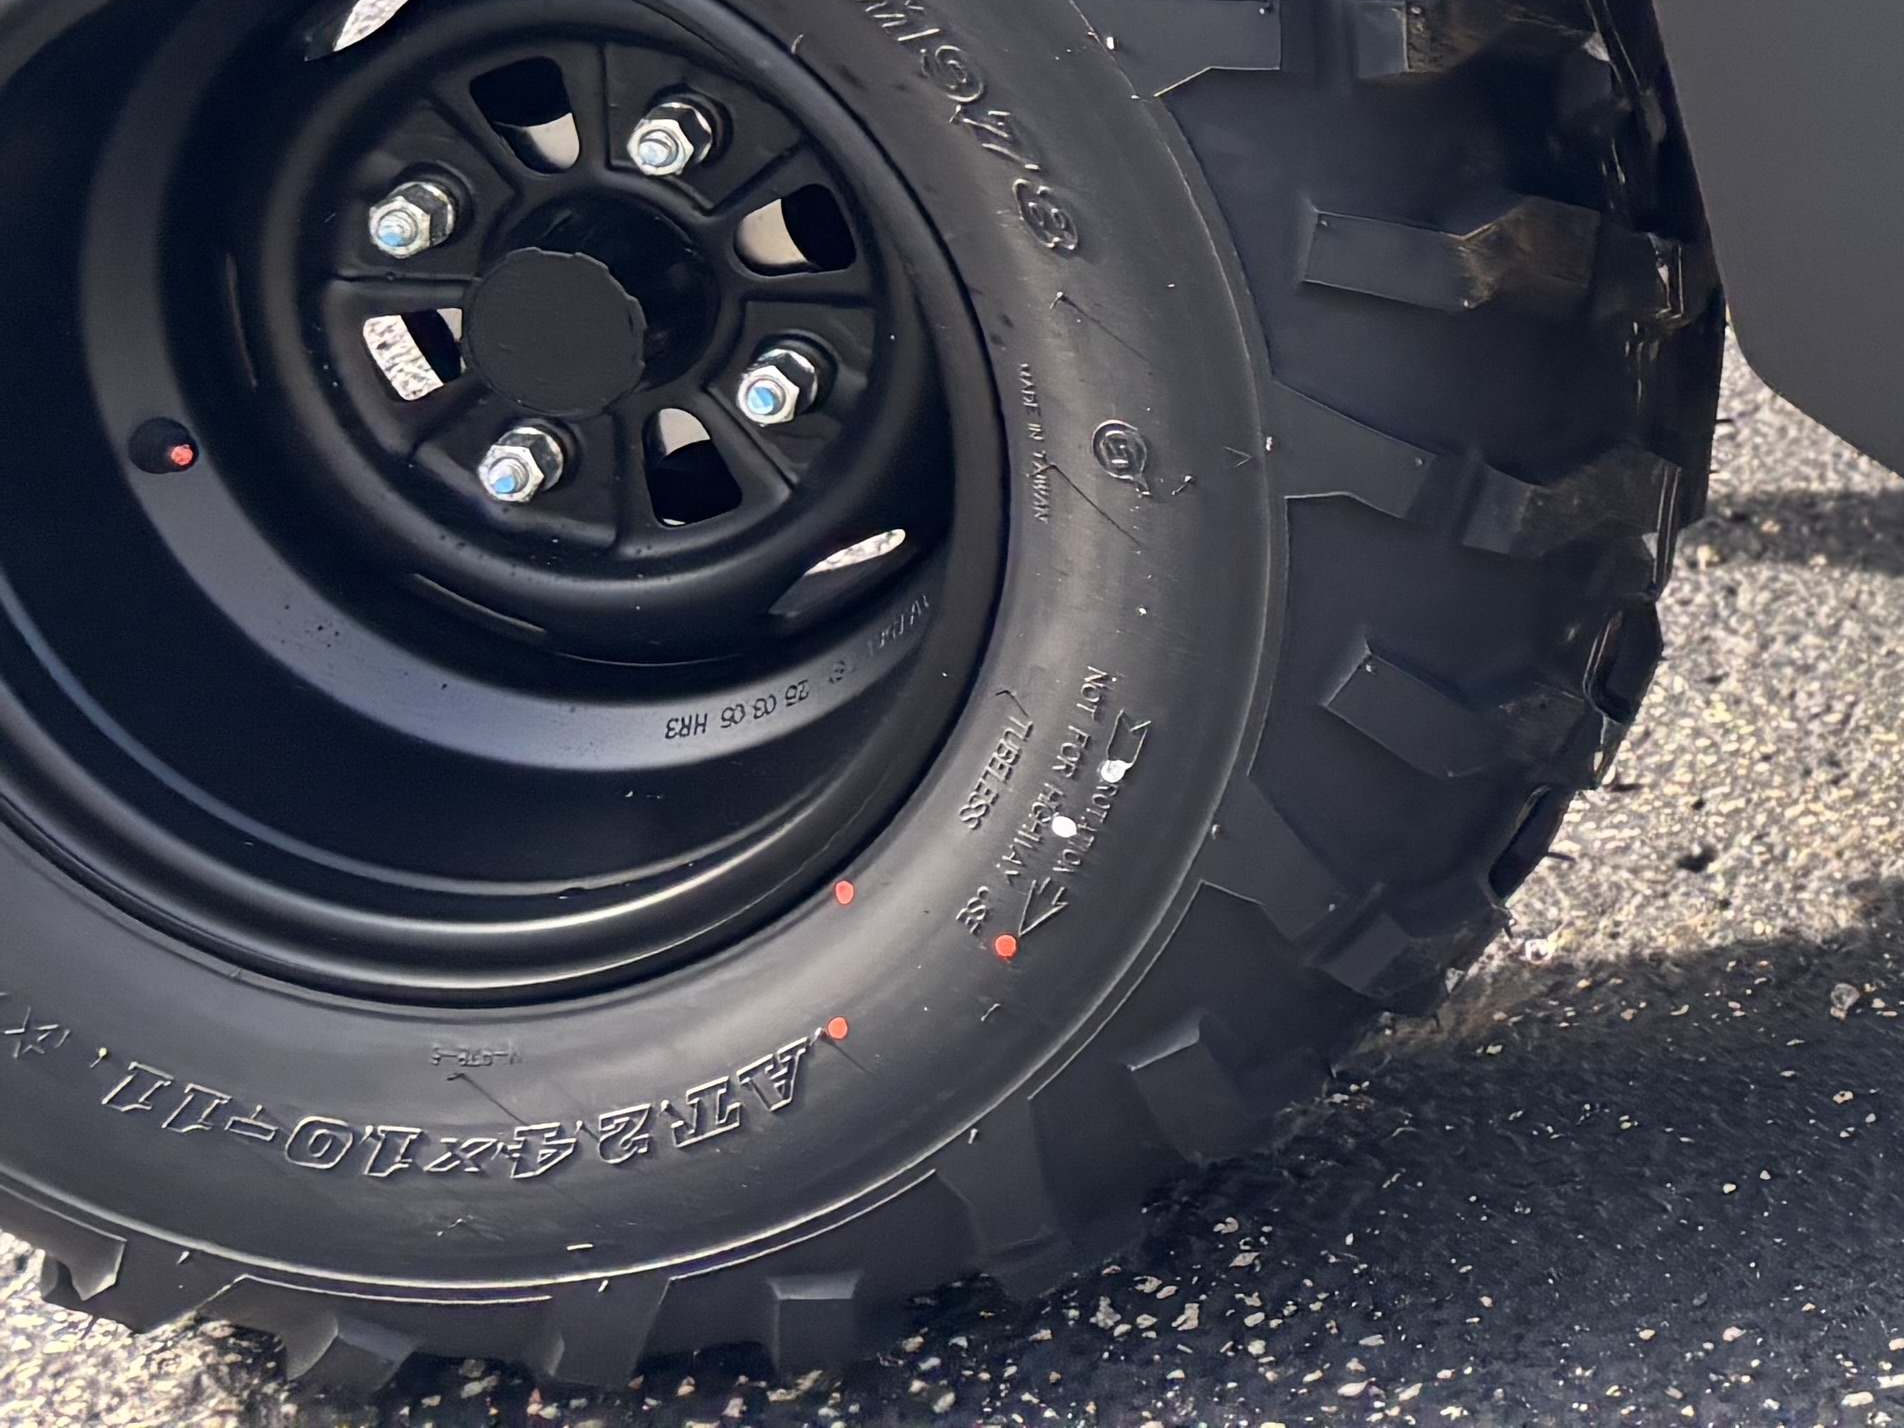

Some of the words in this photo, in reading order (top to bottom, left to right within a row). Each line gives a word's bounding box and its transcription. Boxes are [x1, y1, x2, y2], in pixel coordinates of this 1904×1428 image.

[1019, 362, 1041, 418] MADE
[1027, 422, 1045, 442] IN
[1030, 449, 1051, 524] TAIWAN
[753, 694, 778, 720] 03
[1076, 665, 1110, 720] NOT
[664, 712, 708, 740] HR3
[1050, 724, 1092, 779] FOR
[958, 714, 1035, 831] TUBELESS
[1053, 778, 1120, 874] ROTATION
[100, 1034, 820, 1182] AT24x10-11
